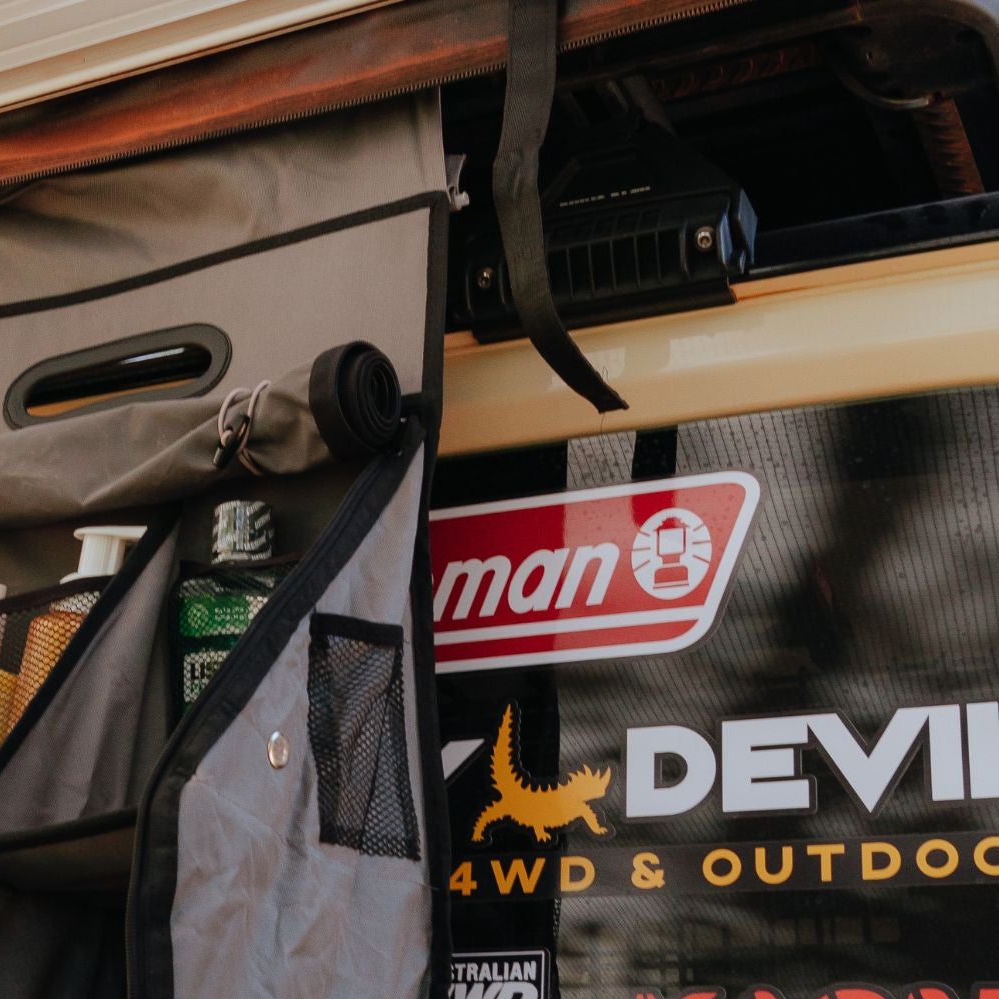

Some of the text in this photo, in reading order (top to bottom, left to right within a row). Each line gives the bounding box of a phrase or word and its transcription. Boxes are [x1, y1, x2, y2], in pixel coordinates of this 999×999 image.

[432, 542, 621, 622] man
[449, 857, 596, 896] 4WD
[631, 852, 665, 889] &
[451, 960, 537, 981] TRALIAN
